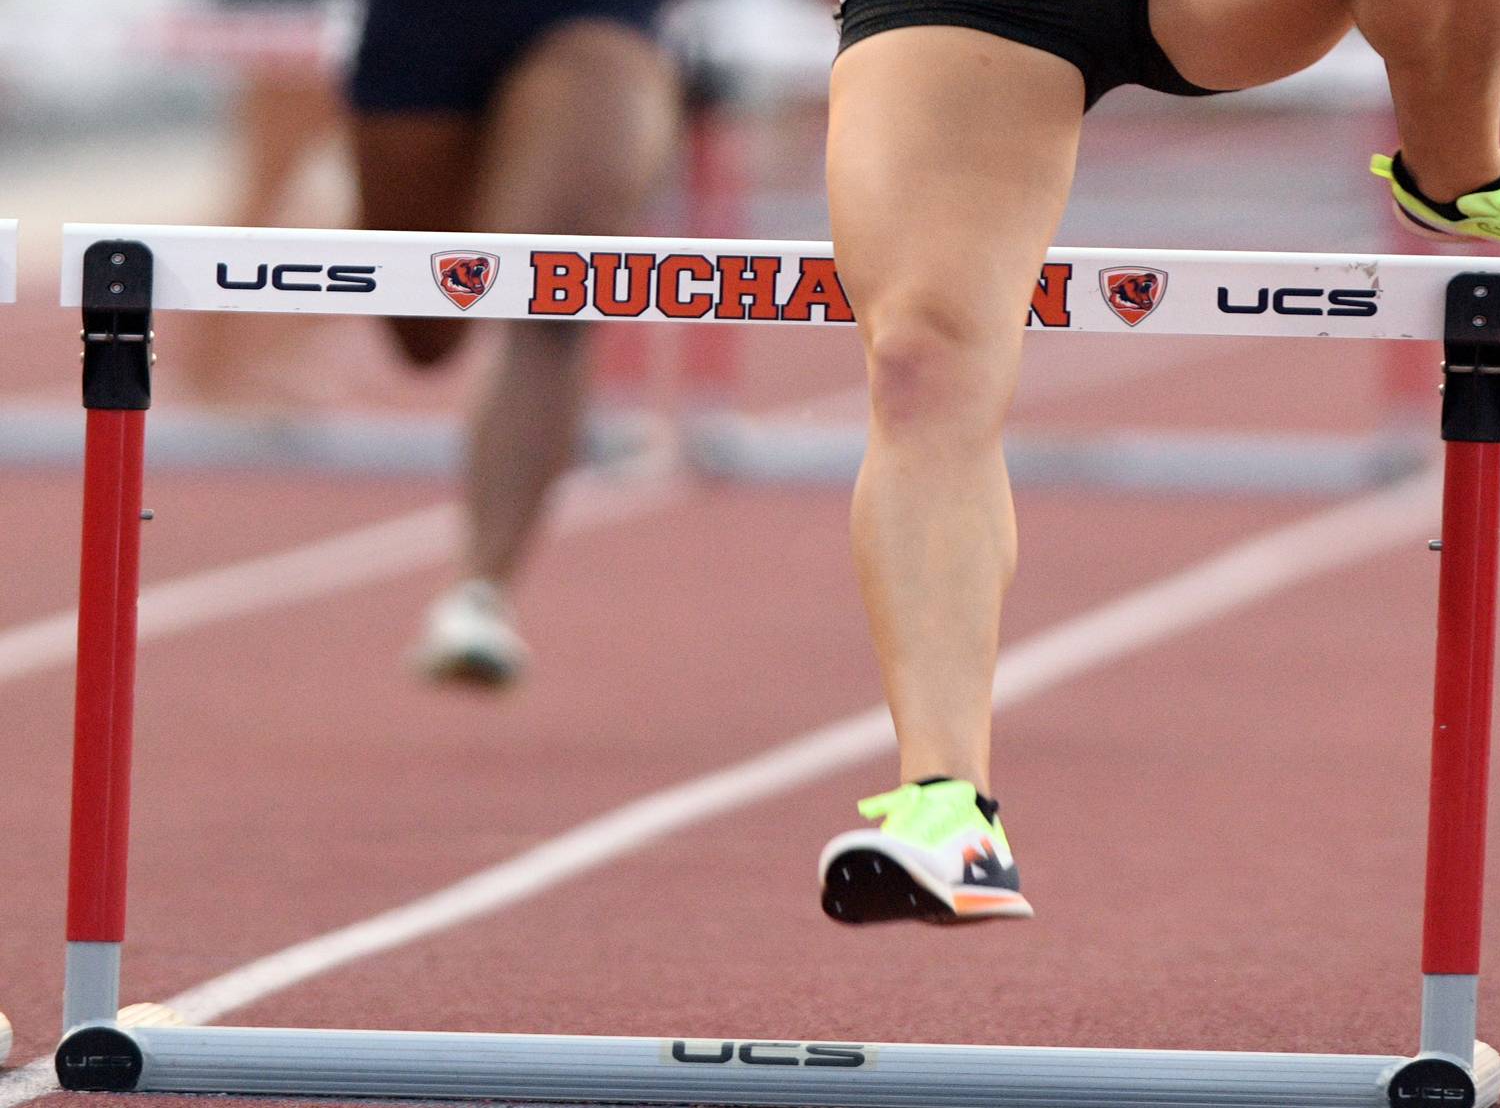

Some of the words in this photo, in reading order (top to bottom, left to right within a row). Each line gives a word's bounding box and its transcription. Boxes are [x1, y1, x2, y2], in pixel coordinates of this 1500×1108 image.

[216, 262, 377, 293] UCS
[528, 250, 1073, 328] BUCHAN
[1217, 286, 1377, 317] UCS
[672, 1039, 865, 1068] UCS
